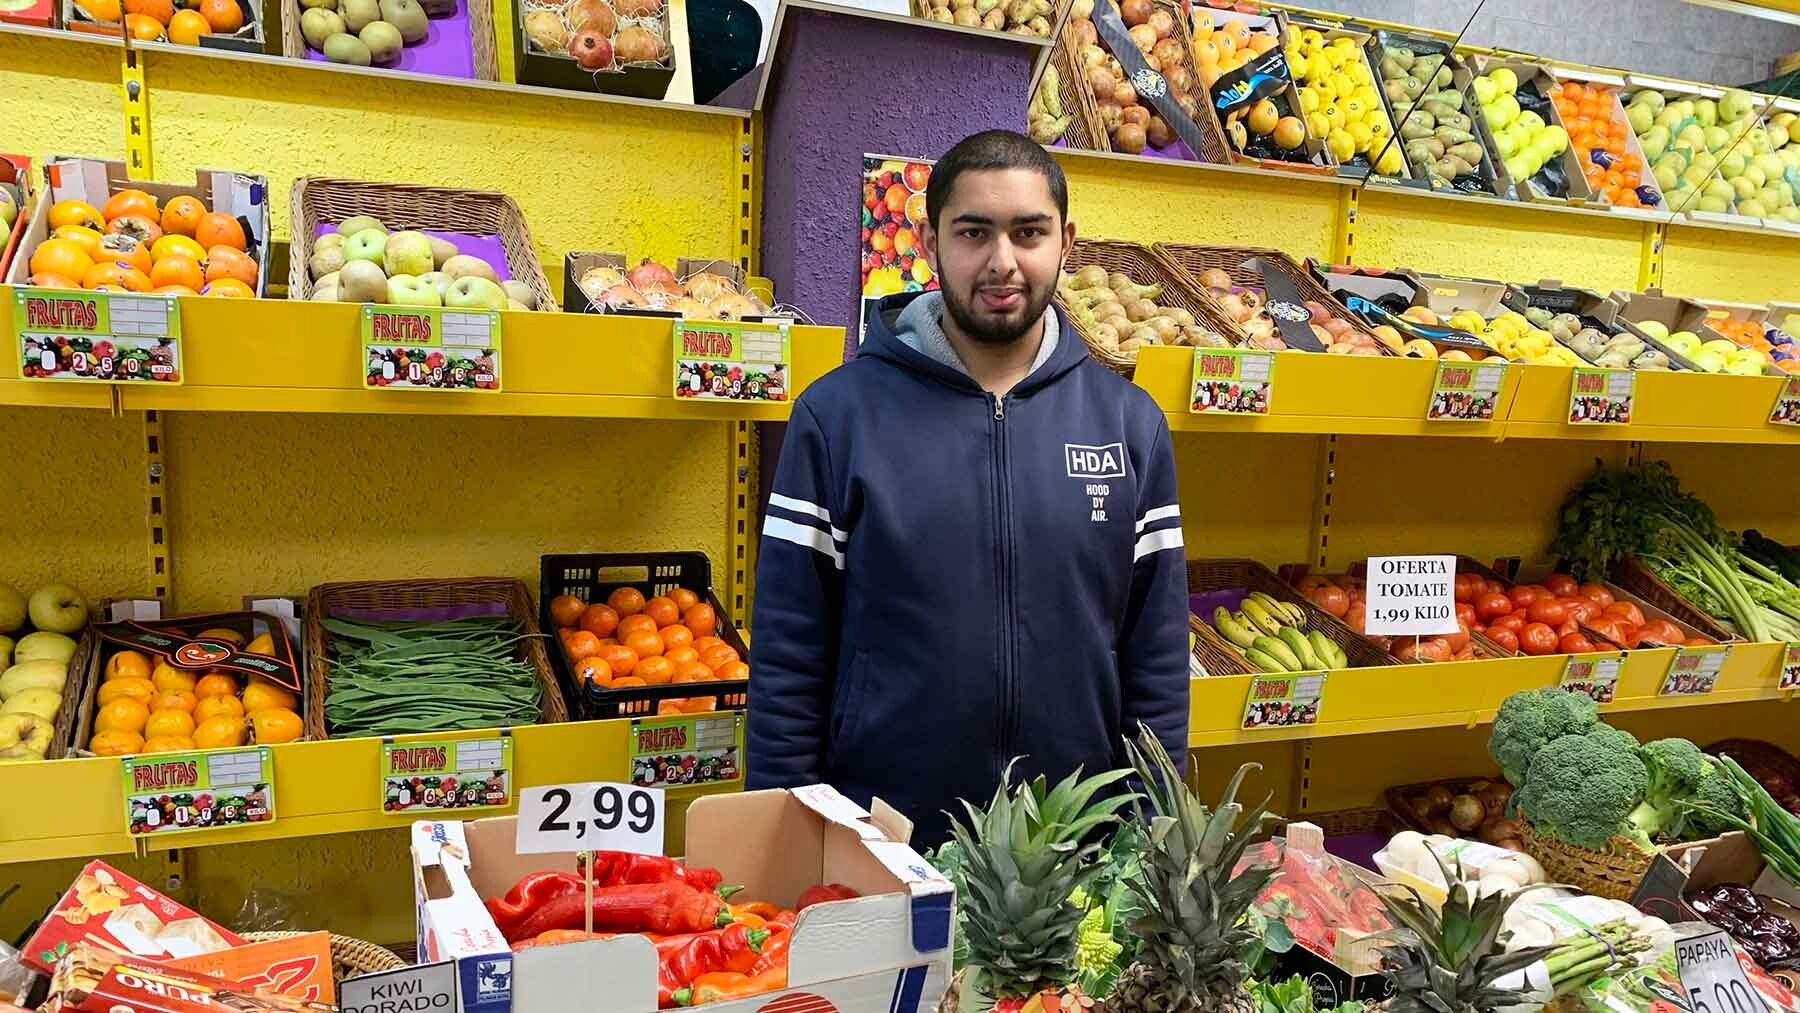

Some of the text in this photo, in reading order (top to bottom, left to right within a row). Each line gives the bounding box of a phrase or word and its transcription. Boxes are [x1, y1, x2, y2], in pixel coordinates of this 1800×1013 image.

[27, 298, 97, 329] FRUTAS
[372, 314, 431, 342] FRUTAS
[683, 330, 732, 358] FRUTAS
[1200, 355, 1235, 377] FRUTAS
[1071, 450, 1118, 472] HDA
[1086, 484, 1109, 496] HOOD
[1093, 497, 1104, 508] DY
[1091, 510, 1108, 521] AIR.
[1381, 560, 1447, 574] OFERTA
[1377, 583, 1448, 597] TOMATE
[1374, 605, 1450, 623] 1,99 KILO
[638, 727, 687, 753] FRUTAS
[391, 746, 447, 772] FRUTAS
[134, 760, 198, 791] FRUTAS
[538, 786, 656, 839] 2,99
[1679, 938, 1732, 967] PAPAYA
[115, 973, 209, 1005] PURO
[371, 978, 422, 1000] KIWI
